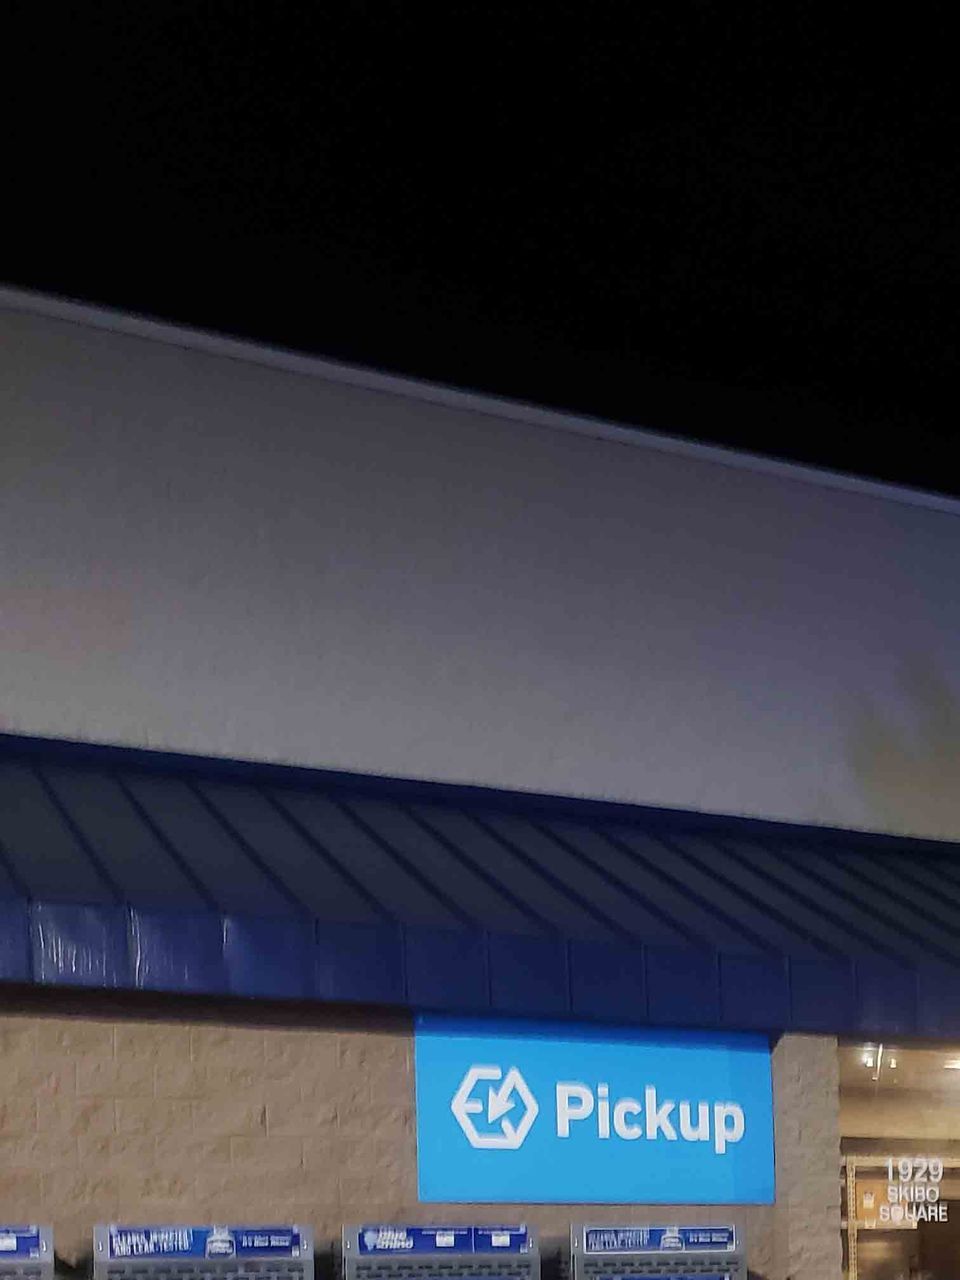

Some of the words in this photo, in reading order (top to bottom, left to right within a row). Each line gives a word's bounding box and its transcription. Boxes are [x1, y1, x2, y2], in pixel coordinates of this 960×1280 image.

[555, 1081, 745, 1154] Pickup
[886, 1157, 944, 1183] 1929
[887, 1184, 940, 1203] SKIBO
[879, 1202, 948, 1222] SQUARE
